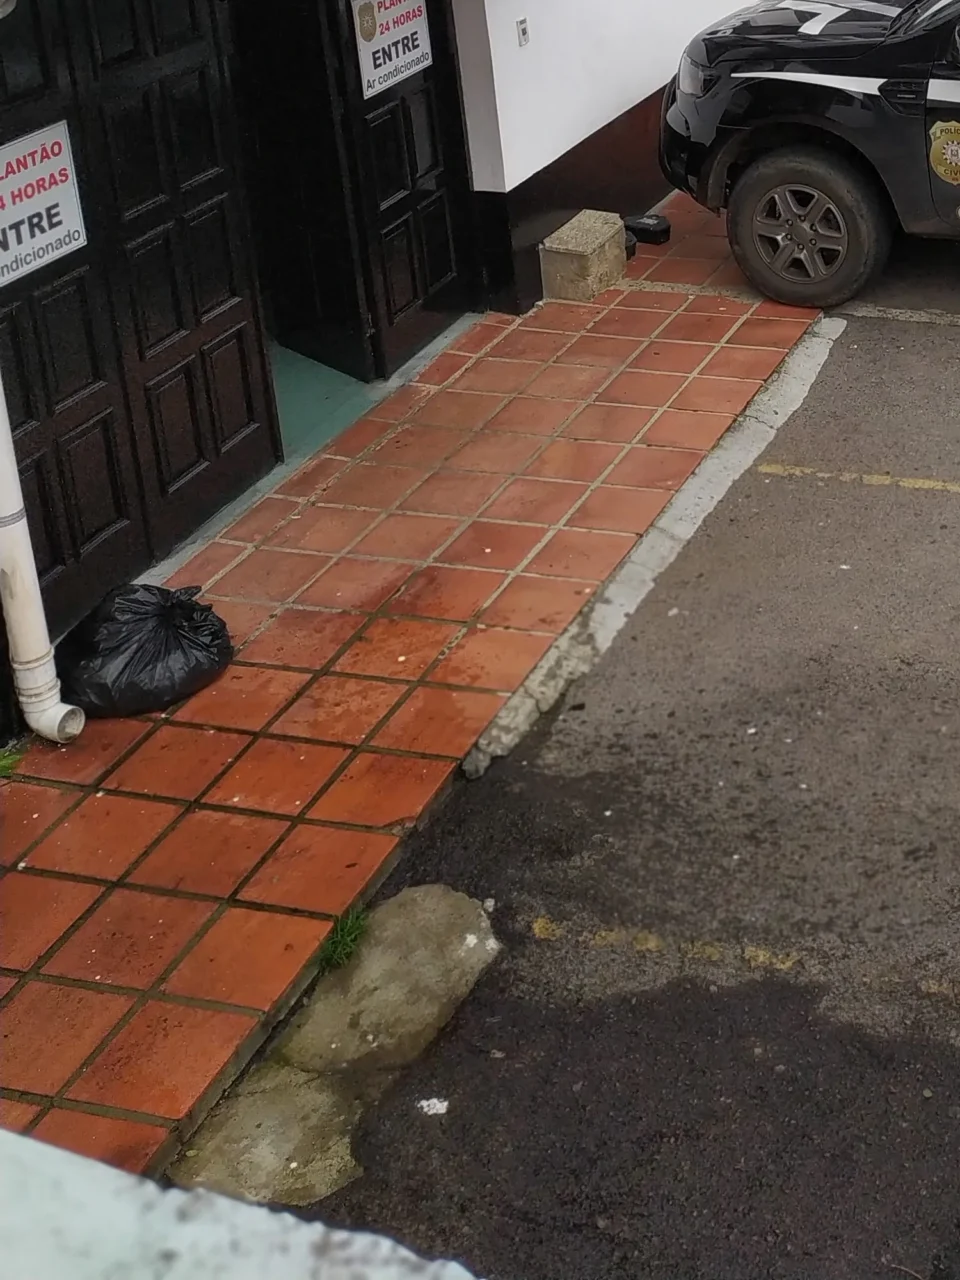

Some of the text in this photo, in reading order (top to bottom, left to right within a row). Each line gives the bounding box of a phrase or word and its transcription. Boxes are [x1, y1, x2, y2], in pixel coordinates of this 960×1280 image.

[379, 5, 423, 37] 24 HORAS
[371, 31, 421, 70] ENTRE
[366, 51, 430, 92] Ar condicionado
[11, 167, 70, 206] HORAS
